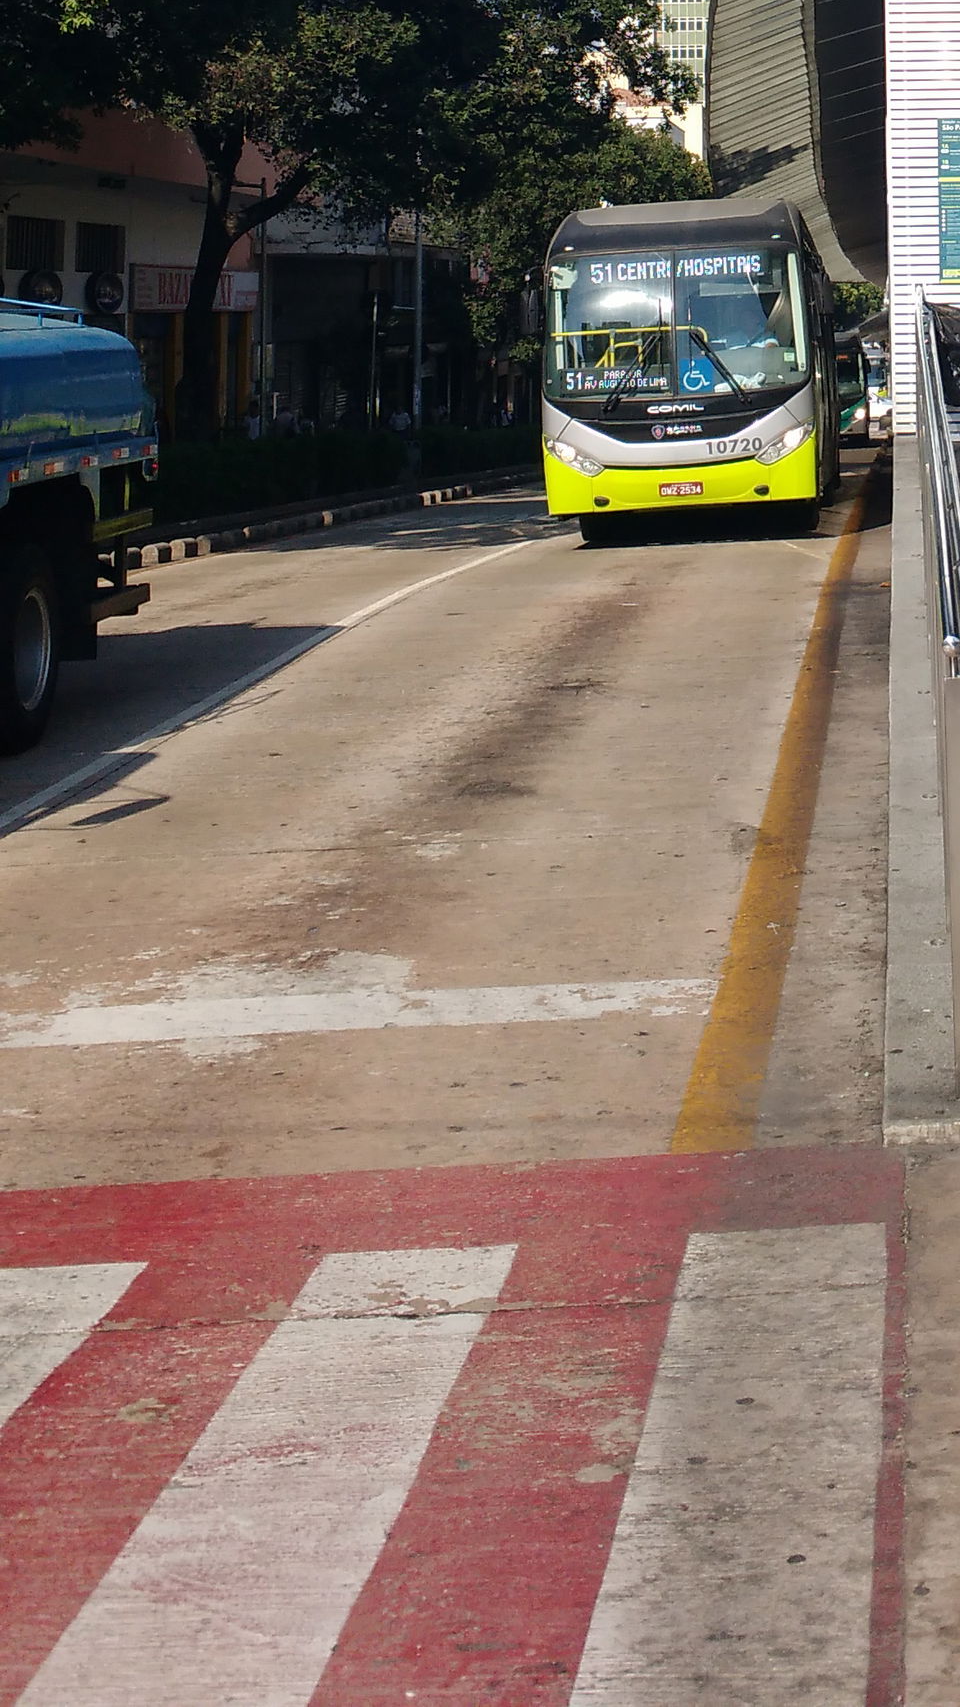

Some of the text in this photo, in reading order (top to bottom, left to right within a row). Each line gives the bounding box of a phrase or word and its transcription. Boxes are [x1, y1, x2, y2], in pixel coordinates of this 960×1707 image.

[590, 263, 613, 284] 51
[566, 372, 582, 390] 51
[598, 378, 636, 389] AUGO
[637, 377, 648, 387] DE
[649, 377, 667, 386] LIMA
[647, 403, 704, 414] COMIL
[706, 437, 762, 455] 10720
